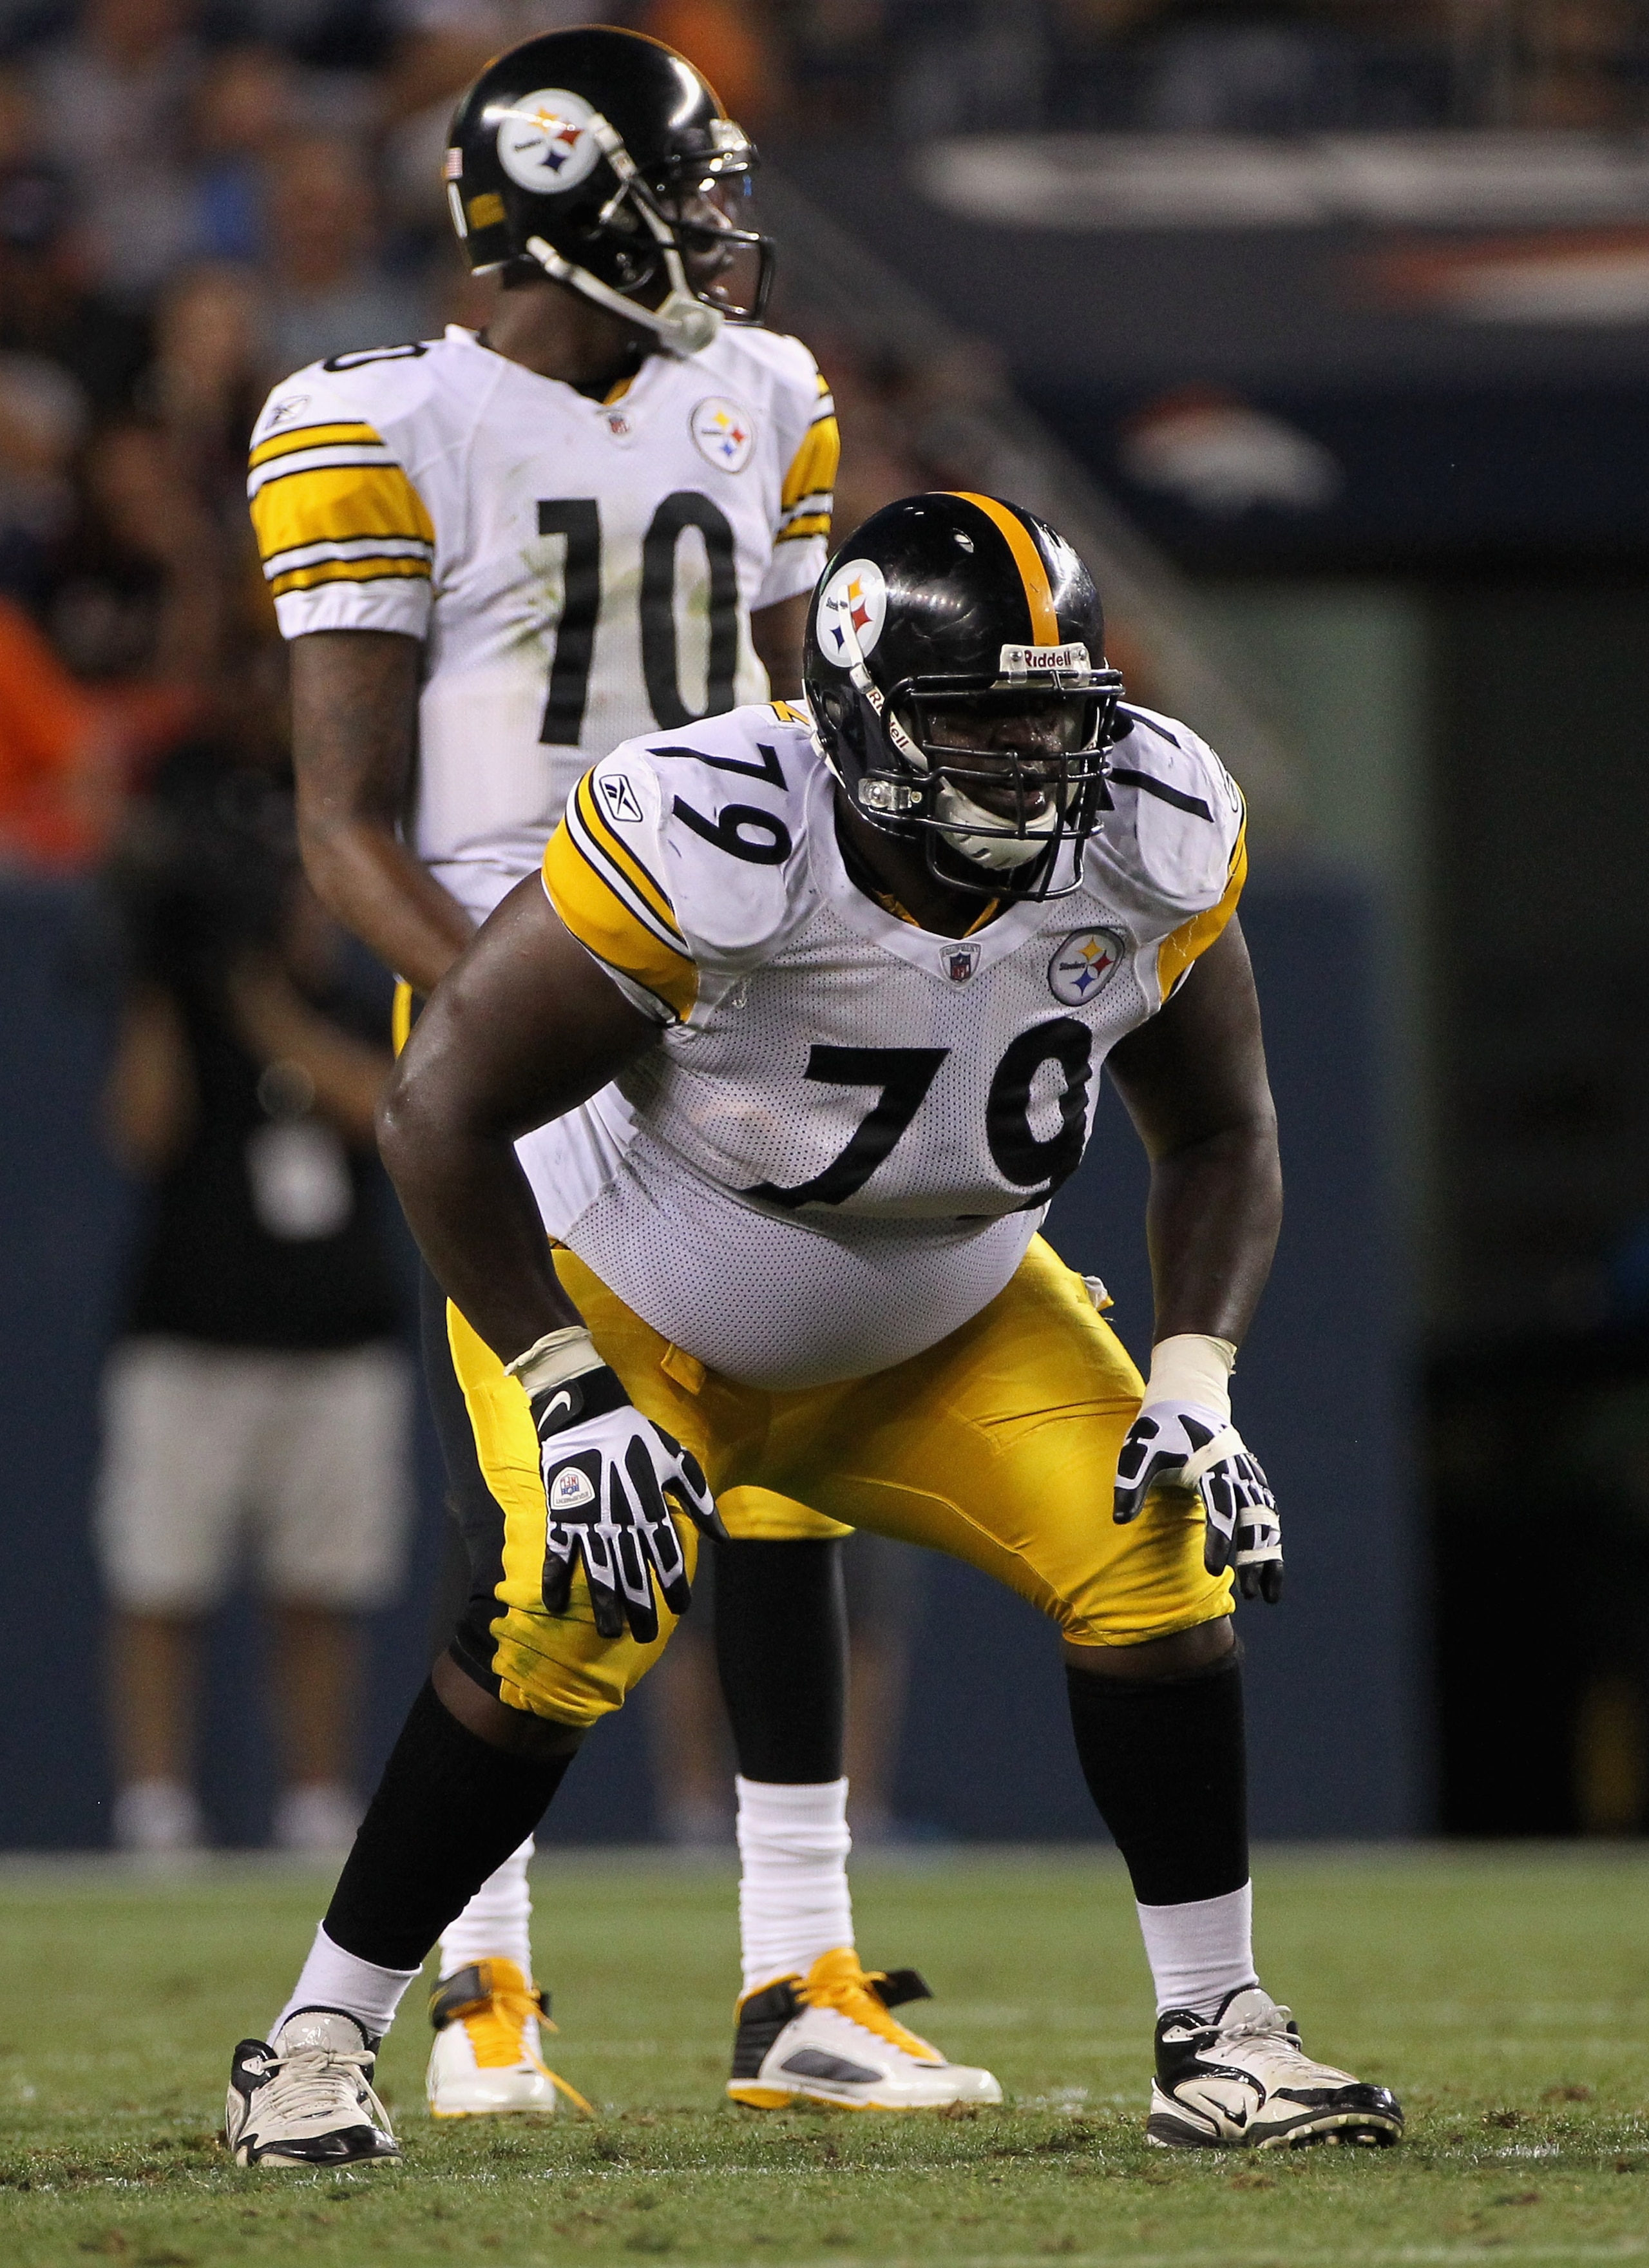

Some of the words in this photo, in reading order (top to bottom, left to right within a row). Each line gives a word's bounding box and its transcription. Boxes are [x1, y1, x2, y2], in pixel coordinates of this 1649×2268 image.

[537, 489, 738, 746] 10
[1024, 649, 1072, 668] Riddell
[645, 742, 793, 865] 79
[739, 1015, 1093, 1220] 79
[560, 1476, 578, 1487] NFL
